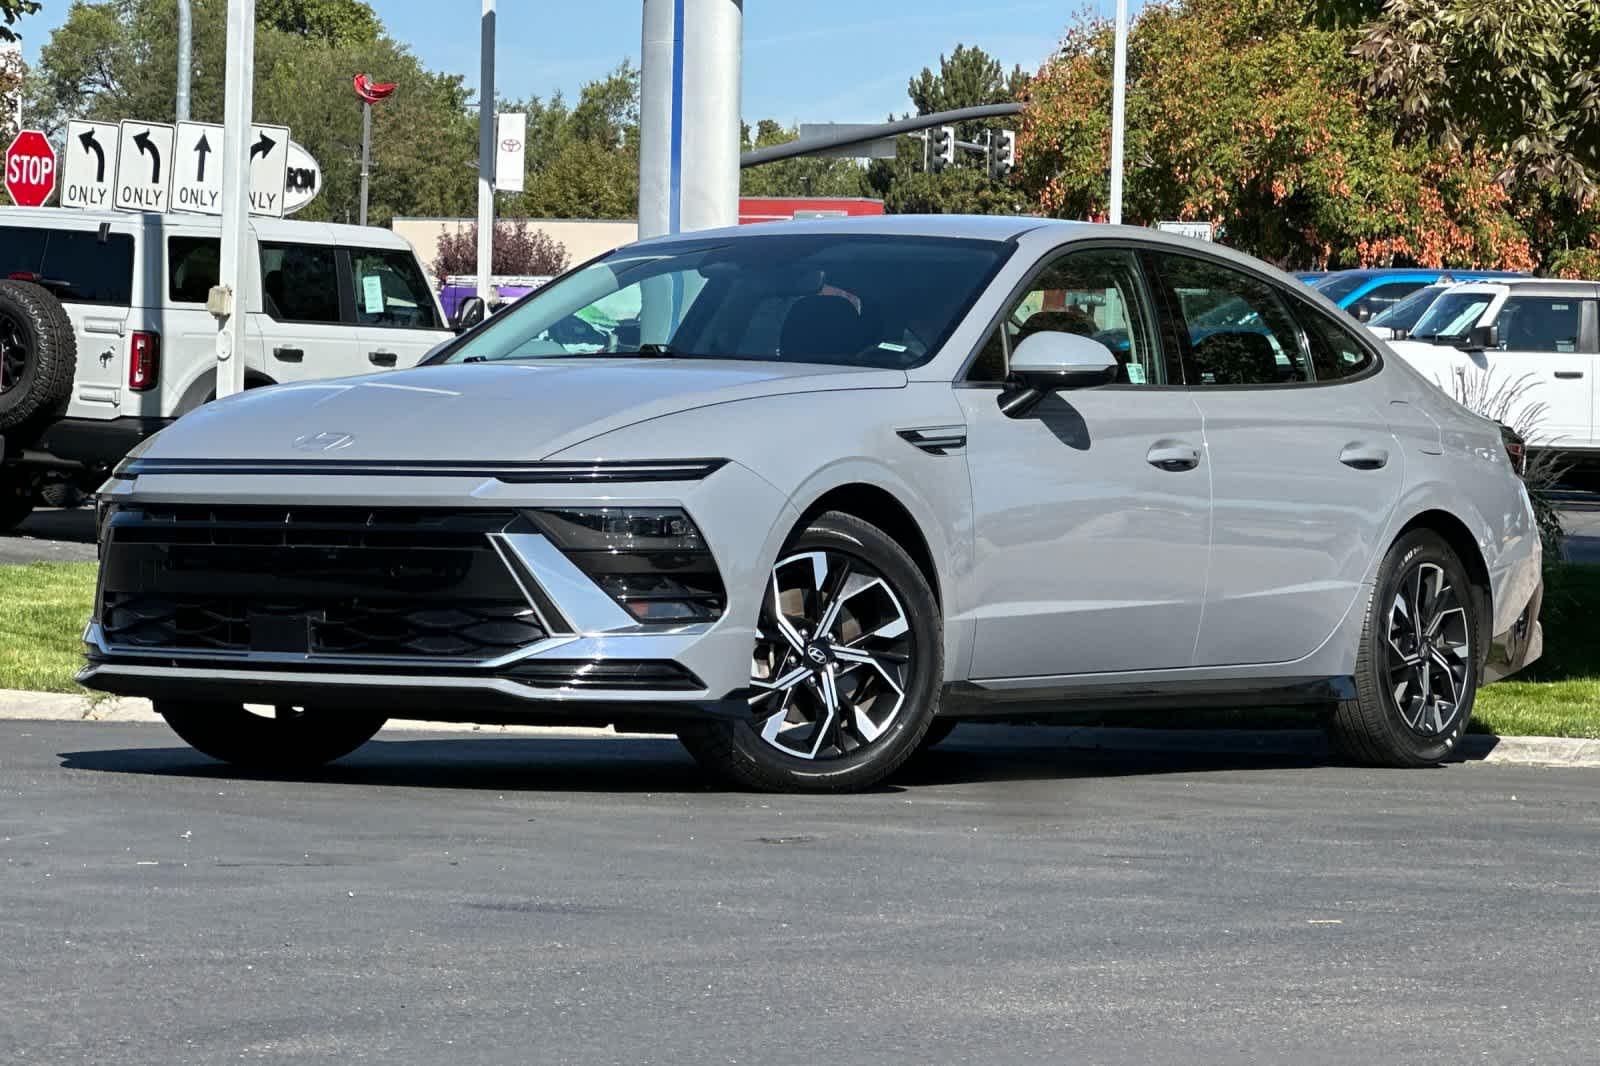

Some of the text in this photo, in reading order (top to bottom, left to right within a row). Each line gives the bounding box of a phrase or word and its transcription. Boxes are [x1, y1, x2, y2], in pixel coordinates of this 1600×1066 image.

[9, 154, 52, 184] STOP
[68, 184, 107, 205] ONLY
[122, 186, 162, 206] ONLY
[180, 187, 218, 207] ONLY
[249, 191, 276, 210] NLY
